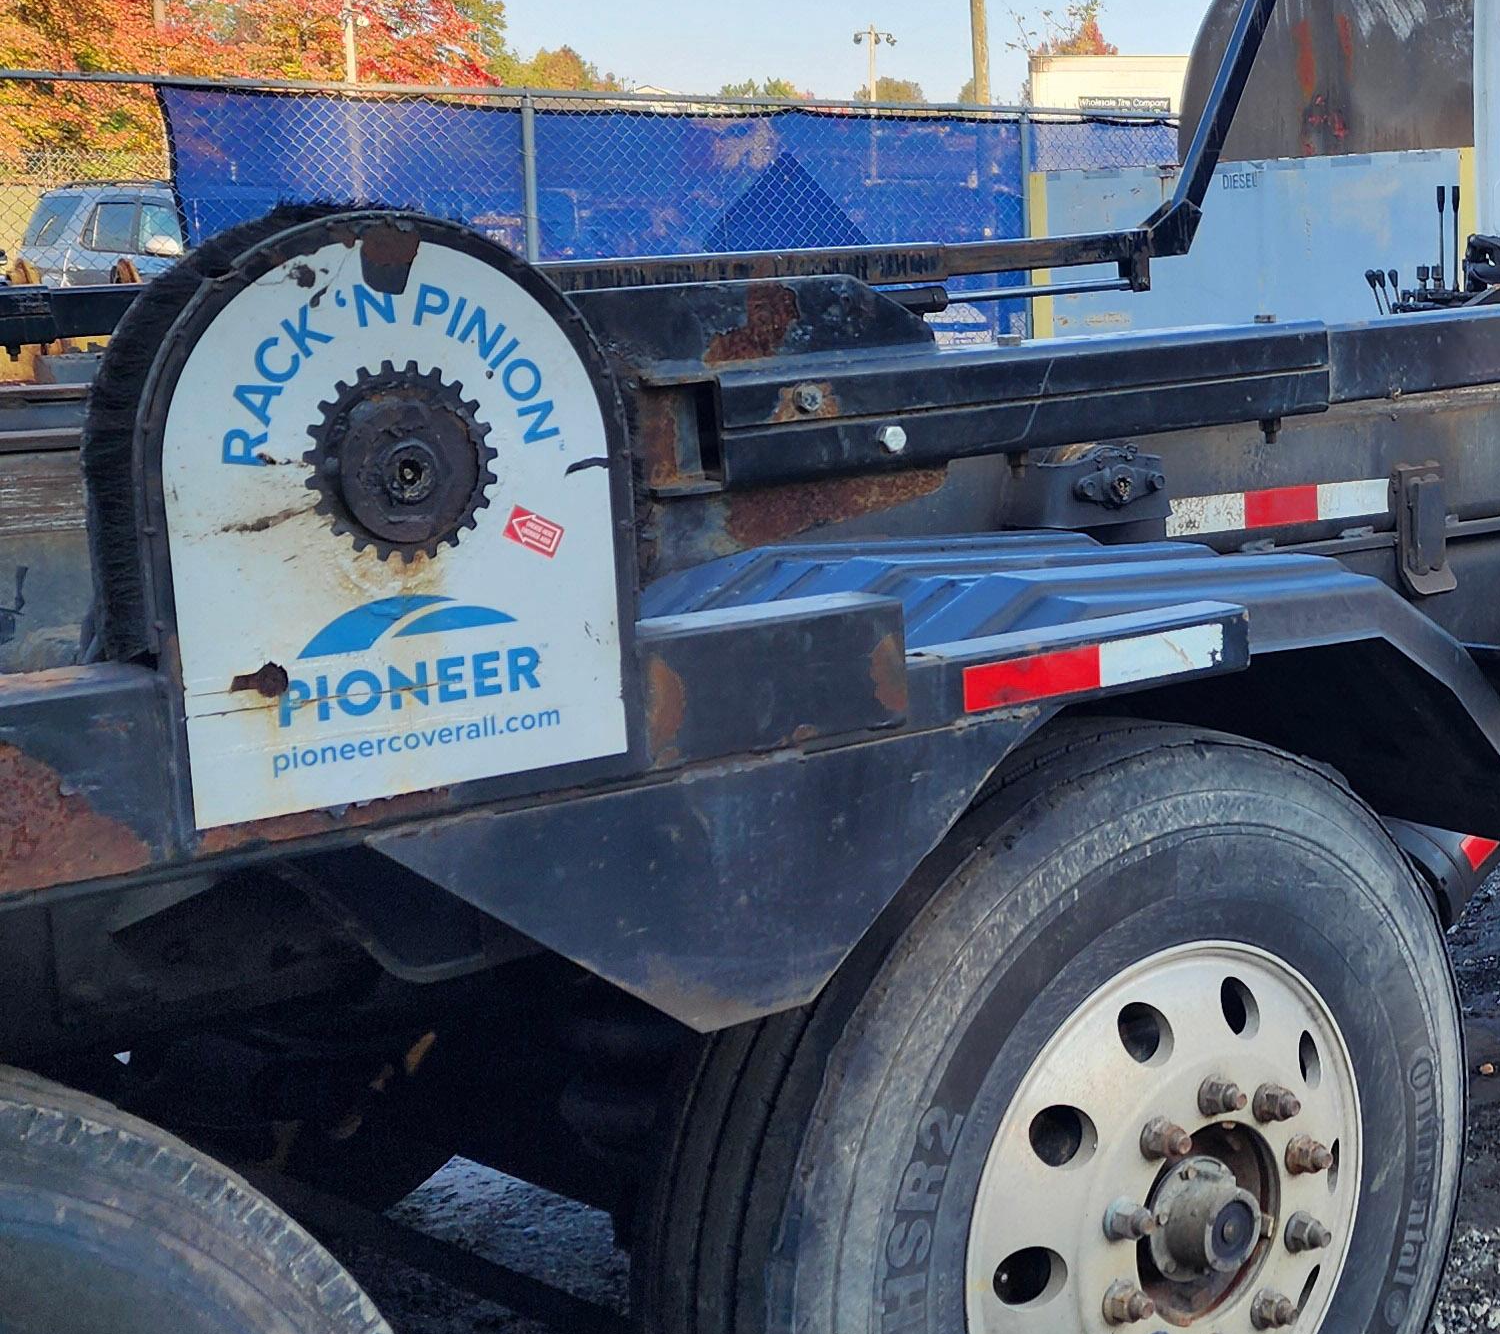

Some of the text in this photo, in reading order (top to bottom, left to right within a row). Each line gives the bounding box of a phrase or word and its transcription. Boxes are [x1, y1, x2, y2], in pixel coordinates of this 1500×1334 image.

[1080, 98, 1169, 110] Wholesale Tire Company
[1222, 172, 1258, 190] DIESEL
[221, 303, 335, 467] RACK
[412, 282, 560, 445] PINION
[278, 646, 541, 728] PIONEER
[272, 709, 561, 778] pioneercoverall.com
